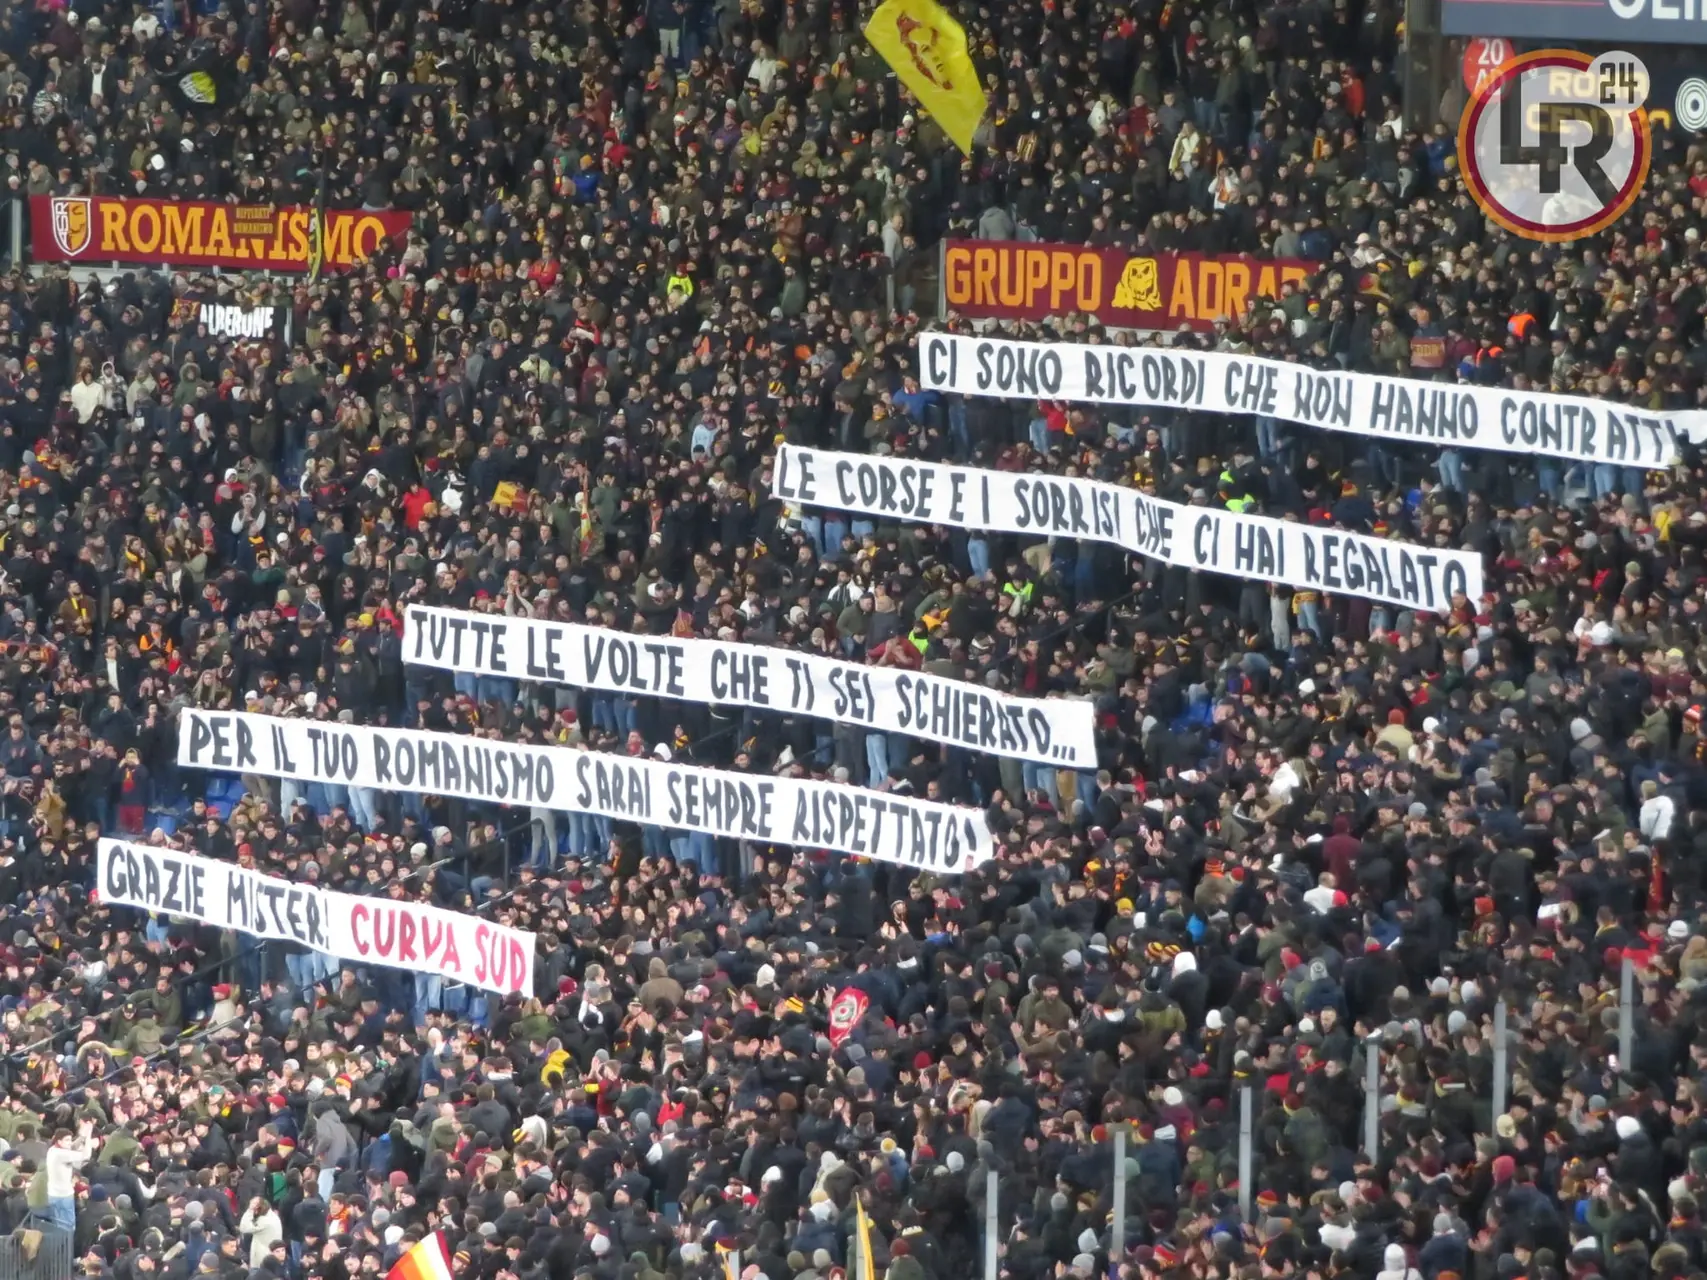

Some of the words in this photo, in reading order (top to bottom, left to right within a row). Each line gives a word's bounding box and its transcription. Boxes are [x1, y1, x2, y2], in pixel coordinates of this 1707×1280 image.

[945, 247, 1102, 312] GRUPPO
[1167, 257, 1307, 320] ADRA
[928, 338, 957, 388] CI
[976, 341, 1063, 395] SONO
[1085, 350, 1206, 406] RICORDI
[1224, 360, 1279, 415] CHE
[1294, 371, 1354, 428] NON
[1369, 381, 1479, 440] HANNO
[1500, 397, 1681, 462] CONTRATTI
[778, 447, 817, 501] LE
[835, 459, 935, 518] CORSE
[948, 471, 965, 523] E
[981, 475, 991, 524] I
[1014, 478, 1121, 540] SORRISI
[1135, 496, 1174, 559] CHE
[1193, 513, 1219, 566] CI
[1234, 521, 1286, 577] HAI
[1303, 530, 1467, 608] REGALATO
[410, 610, 508, 672] TUTTE
[526, 626, 566, 681] LE
[583, 633, 685, 697] VOLTE
[710, 647, 770, 706] CHE
[785, 657, 815, 712] TI
[828, 666, 876, 723] SEI
[894, 673, 1076, 762] SCHIERATO...
[188, 713, 257, 769] PER
[271, 723, 297, 774] IL
[307, 727, 359, 780] TUO
[372, 732, 555, 803] ROMANISMO
[575, 754, 651, 818] SARAI
[667, 769, 775, 838] SEMPRE
[792, 786, 978, 869] RISPETTATO!
[106, 844, 205, 918] GRAZIE
[227, 869, 330, 951] MISTER!
[351, 902, 462, 973] CURVA
[474, 923, 527, 992] SUD
